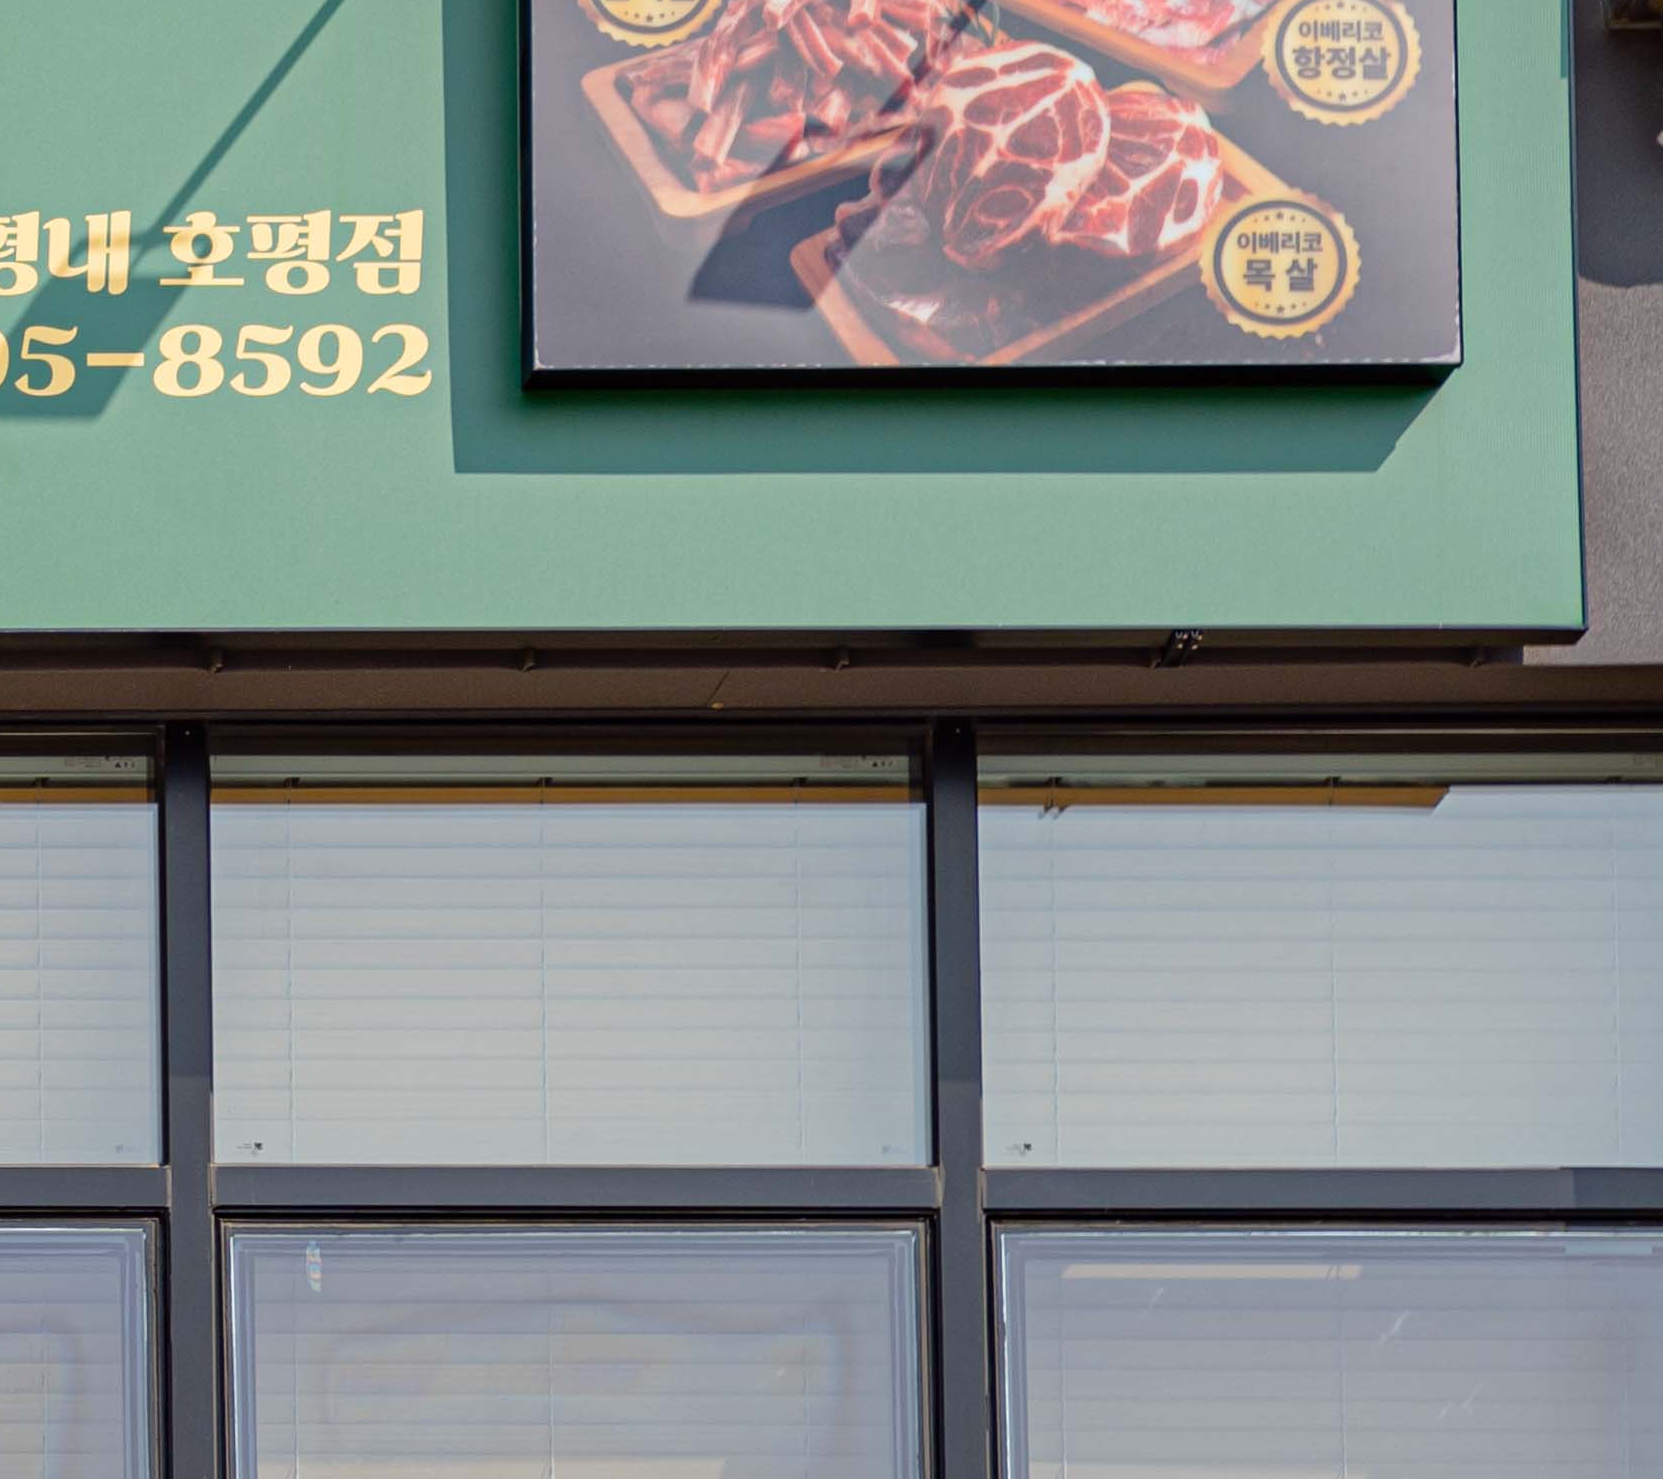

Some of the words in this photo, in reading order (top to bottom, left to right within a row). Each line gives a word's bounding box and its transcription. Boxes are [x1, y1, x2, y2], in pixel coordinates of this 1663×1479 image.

[1298, 19, 1385, 43] 이베리코
[1292, 46, 1392, 81] 항정살
[159, 209, 425, 297] 호평점
[1236, 231, 1324, 254] 이베리코
